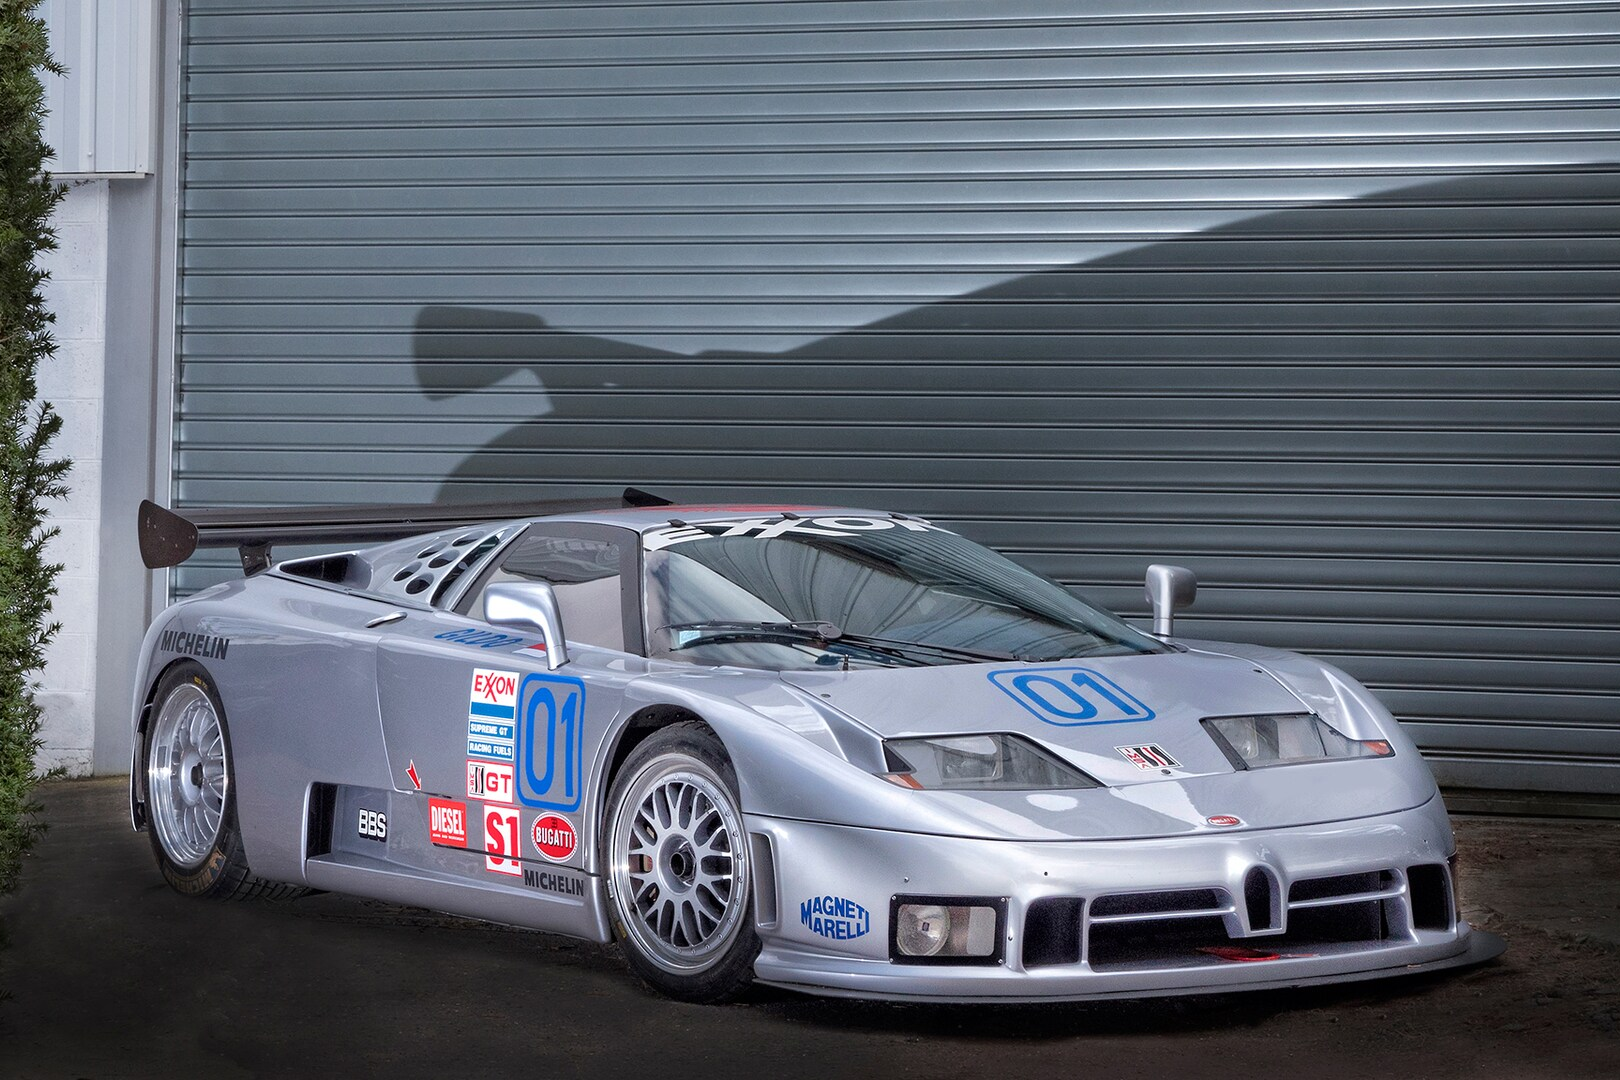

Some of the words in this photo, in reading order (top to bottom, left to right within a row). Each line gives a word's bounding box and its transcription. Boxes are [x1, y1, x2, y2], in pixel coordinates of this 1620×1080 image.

[160, 630, 230, 660] MICHELIN
[474, 672, 516, 702] EXXON
[1012, 672, 1141, 719] 01
[470, 723, 498, 735] SUPREME
[499, 727, 509, 736] GT
[525, 687, 578, 797] 01
[470, 742, 492, 754] RACING
[493, 745, 512, 757] FUELS
[486, 771, 512, 793] GT
[358, 808, 387, 842] BBS
[431, 805, 465, 836] DIESEL
[486, 811, 520, 867] S1
[536, 831, 573, 850] BUGATTI
[524, 869, 585, 896] MICHELIN
[800, 895, 870, 926] MAGNETI
[800, 909, 870, 940] MARELLI
